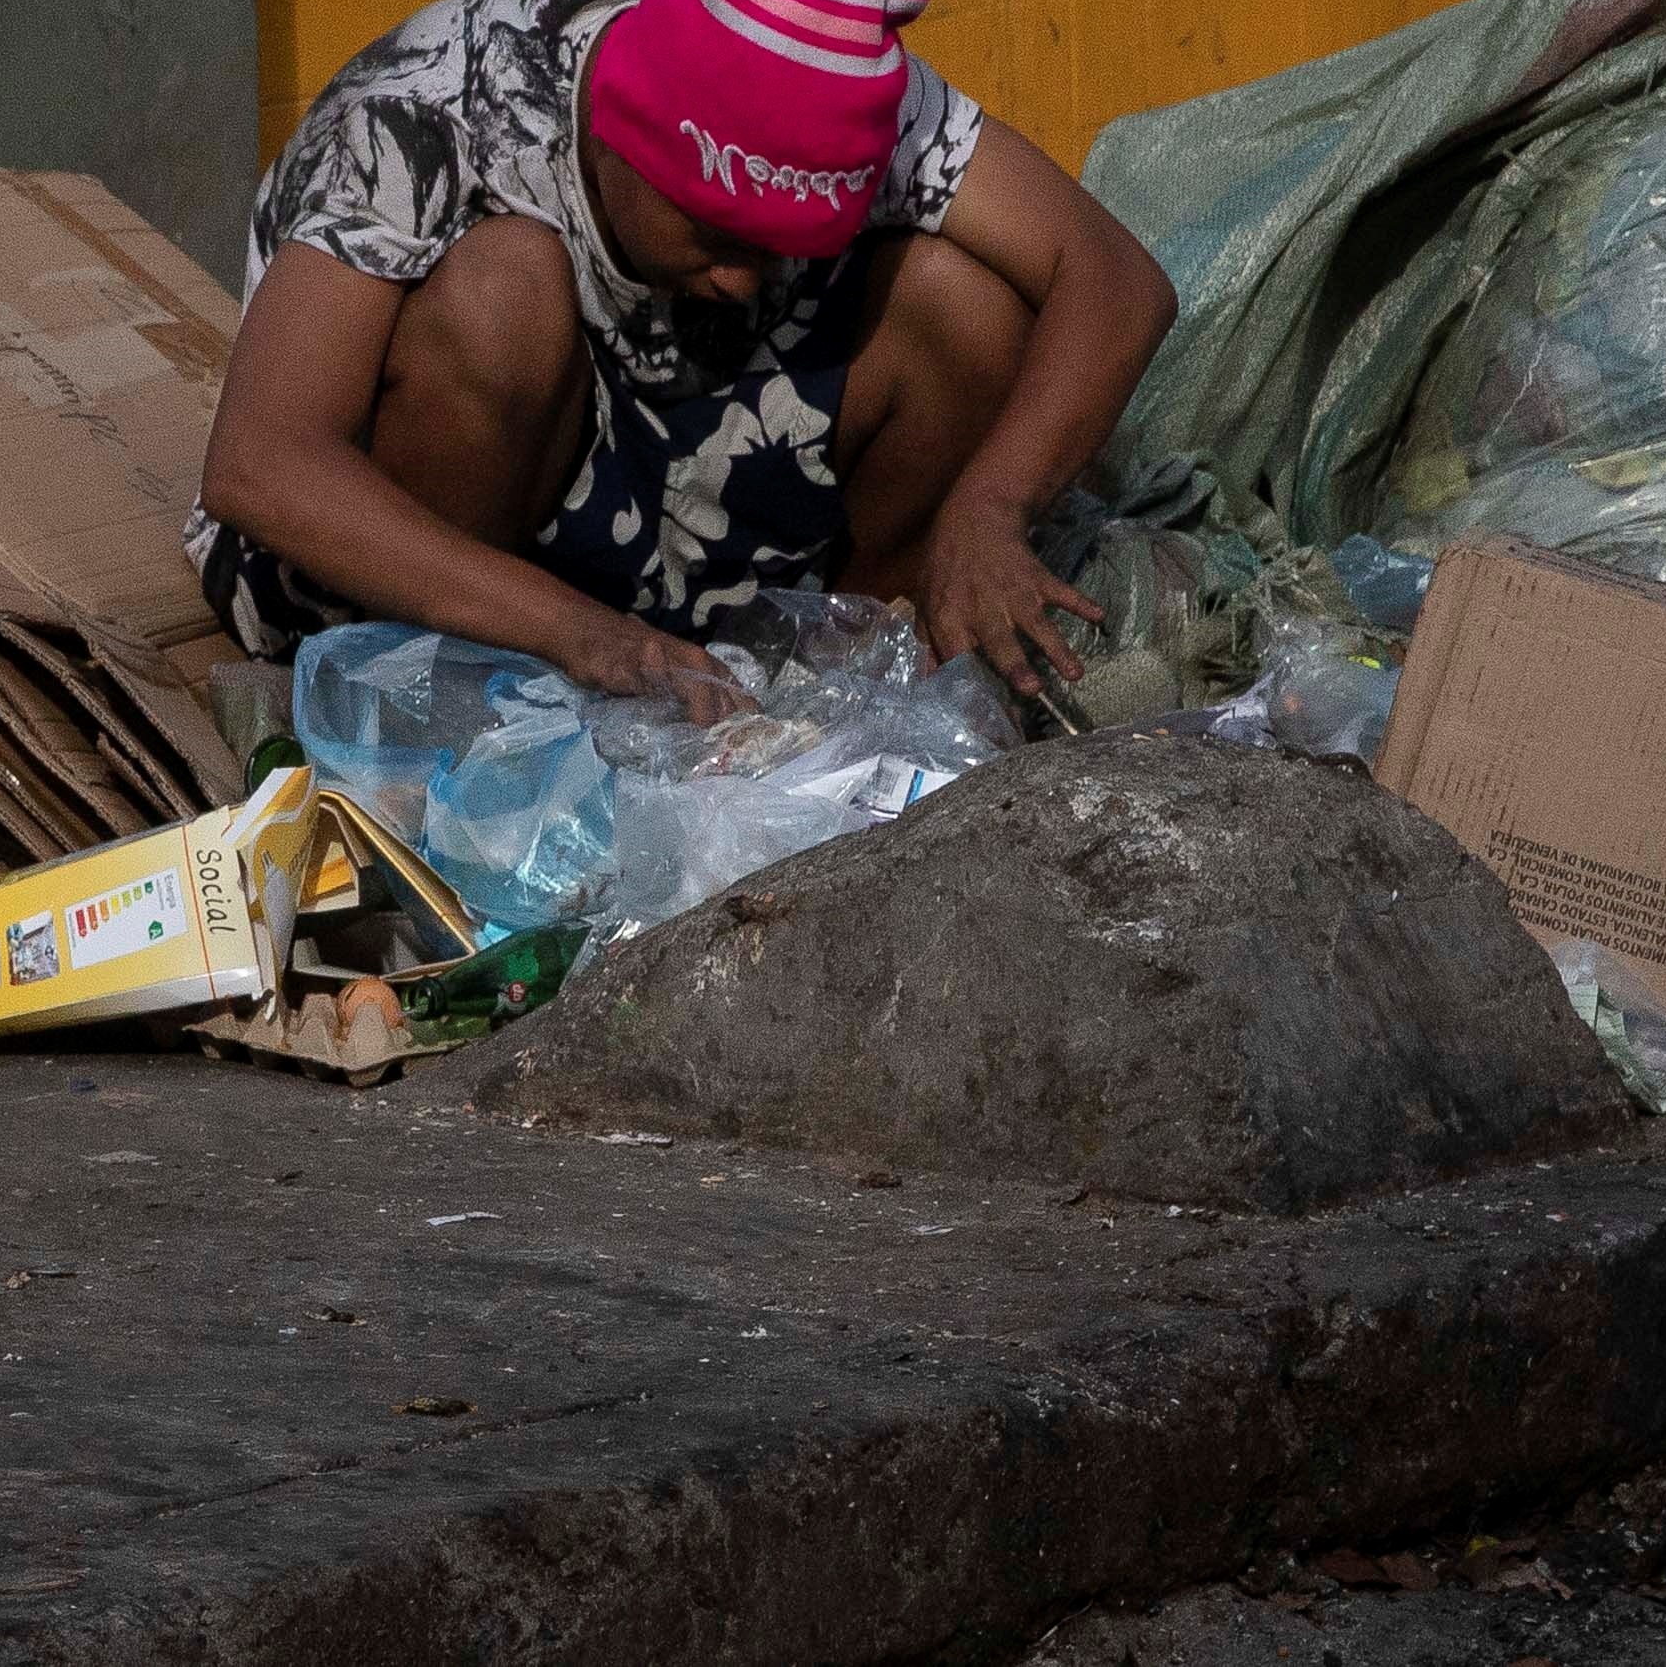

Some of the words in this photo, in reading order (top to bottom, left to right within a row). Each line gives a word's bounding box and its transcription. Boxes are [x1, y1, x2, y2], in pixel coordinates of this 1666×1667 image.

[1488, 827, 1559, 860] VENEZUELA
[1559, 850, 1578, 866] DE
[1578, 856, 1662, 893] BOLIVARIANA
[1583, 874, 1625, 899] POLAR
[196, 848, 237, 935] Social
[1558, 901, 1608, 928] ESTADO
[1584, 892, 1657, 926] ALIMENTOS
[1569, 922, 1611, 947] POLAR
